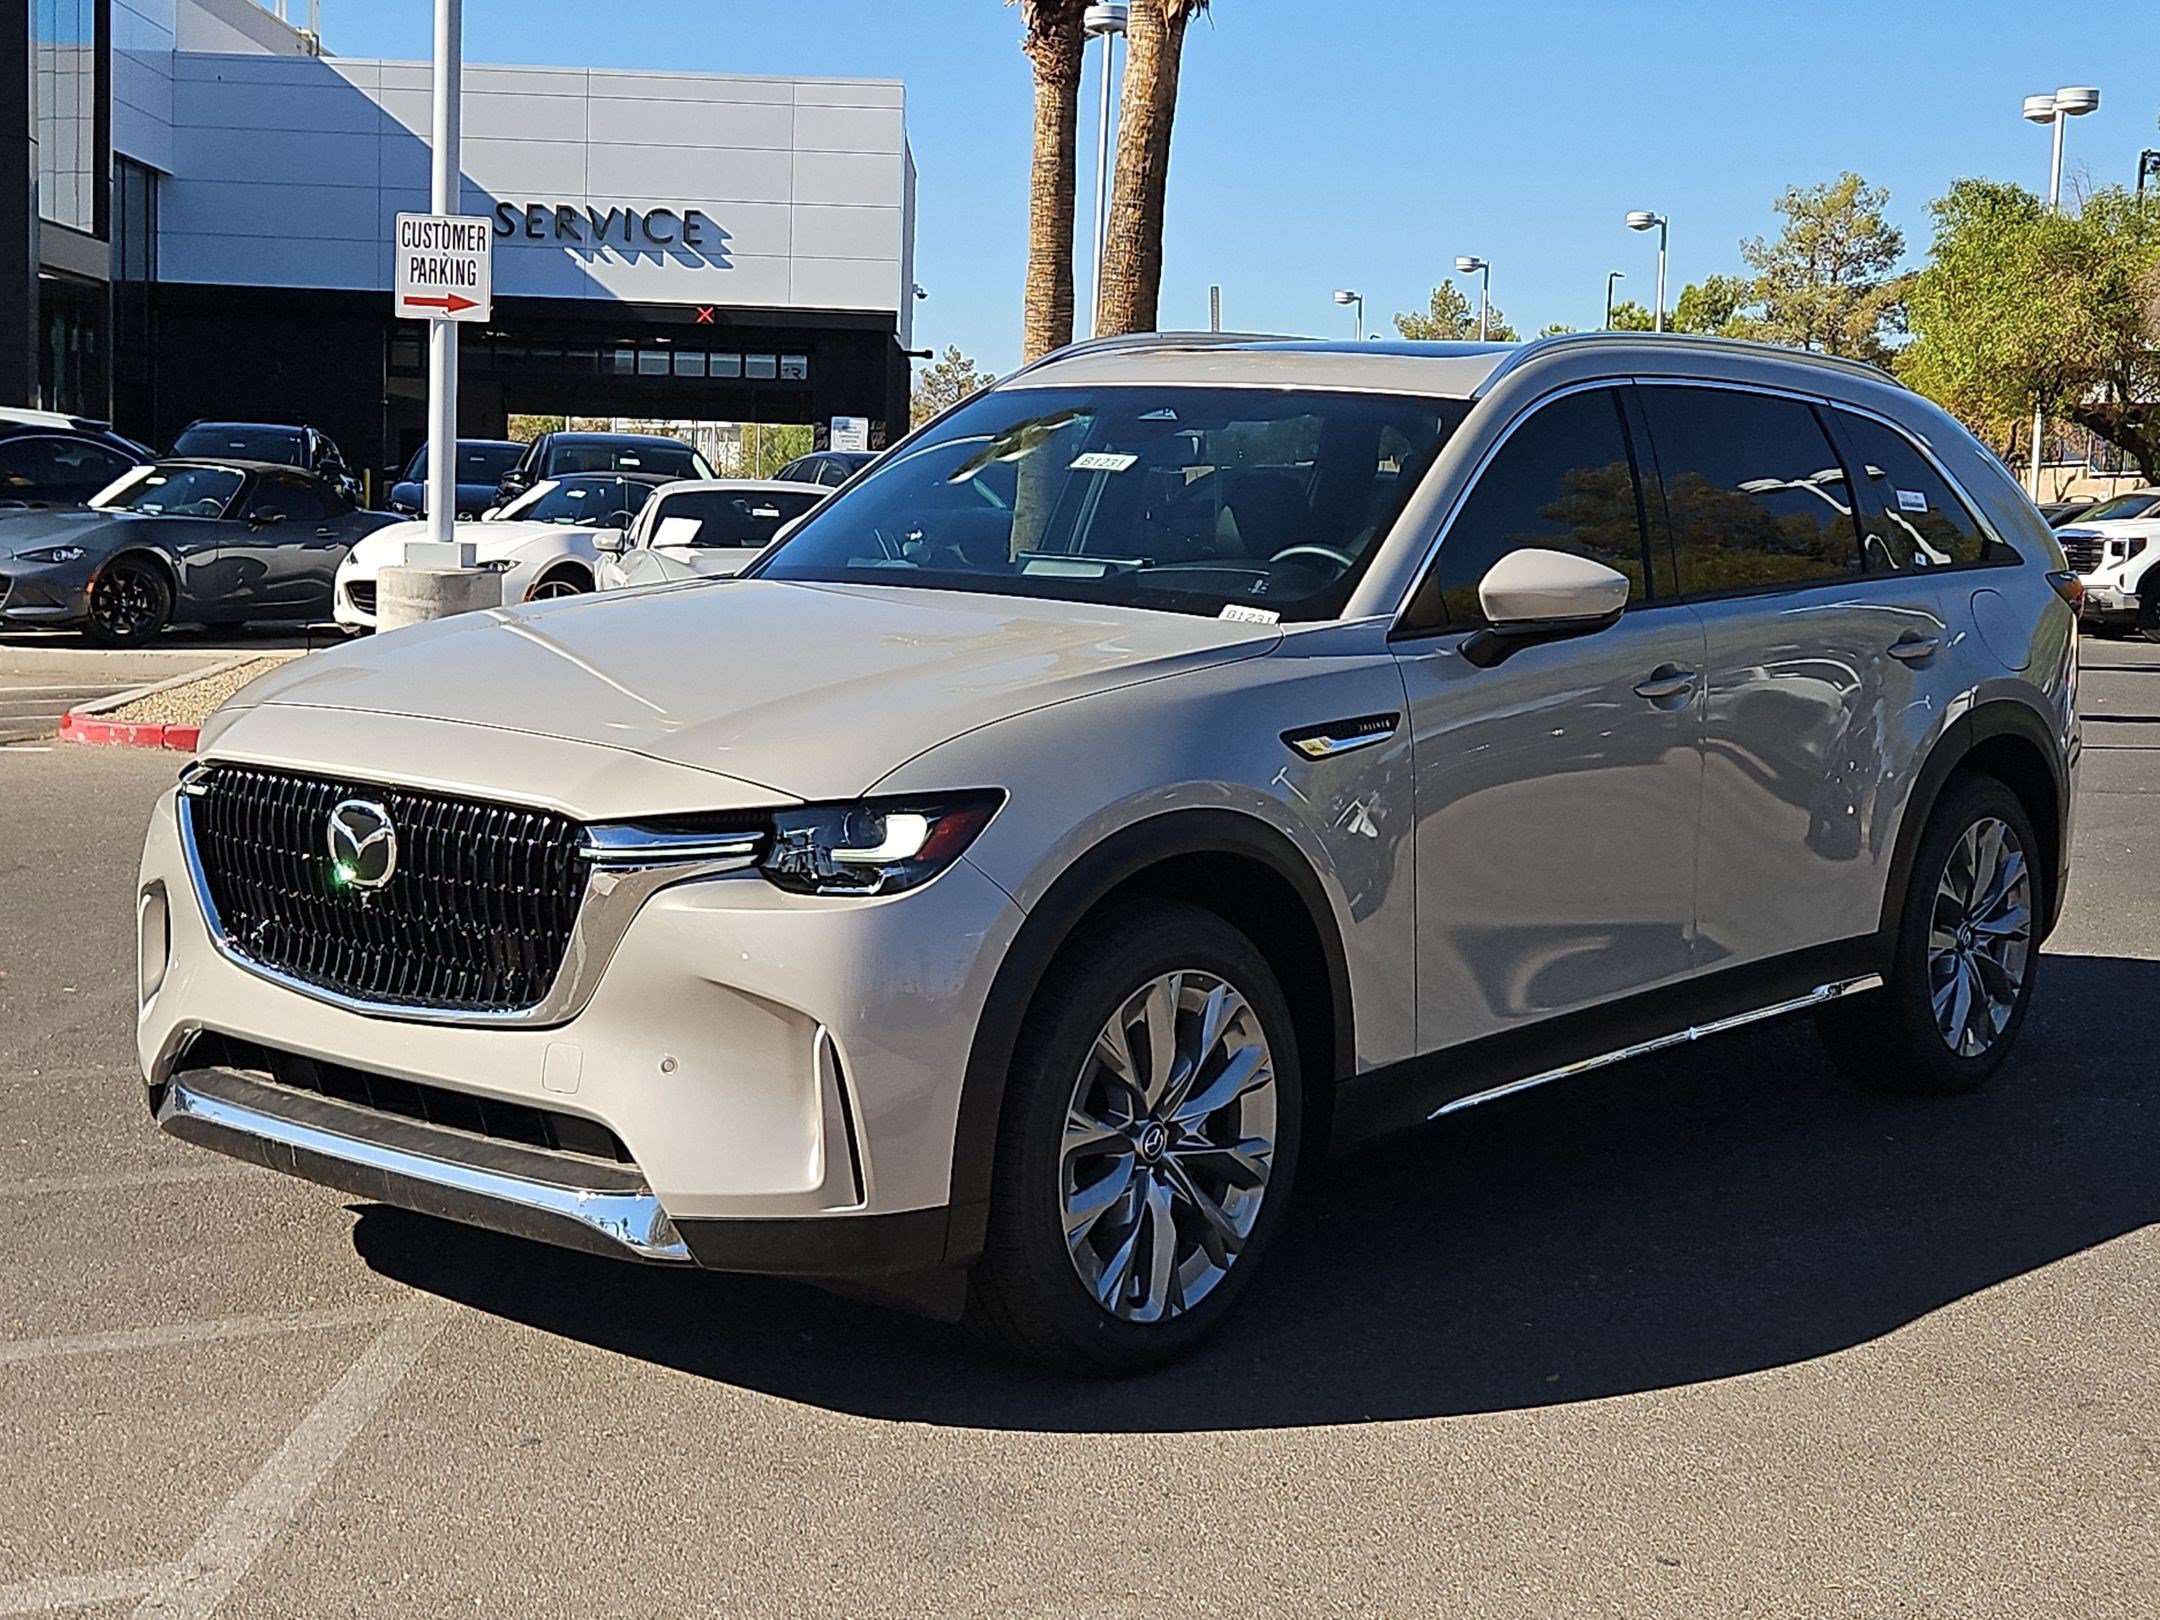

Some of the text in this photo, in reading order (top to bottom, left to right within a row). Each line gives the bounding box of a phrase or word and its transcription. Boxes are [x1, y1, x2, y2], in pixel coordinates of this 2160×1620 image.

[401, 221, 486, 252] CUSTOMER
[493, 202, 703, 244] SERVICE
[409, 256, 476, 287] PARKING
[1079, 456, 1126, 468] B1231
